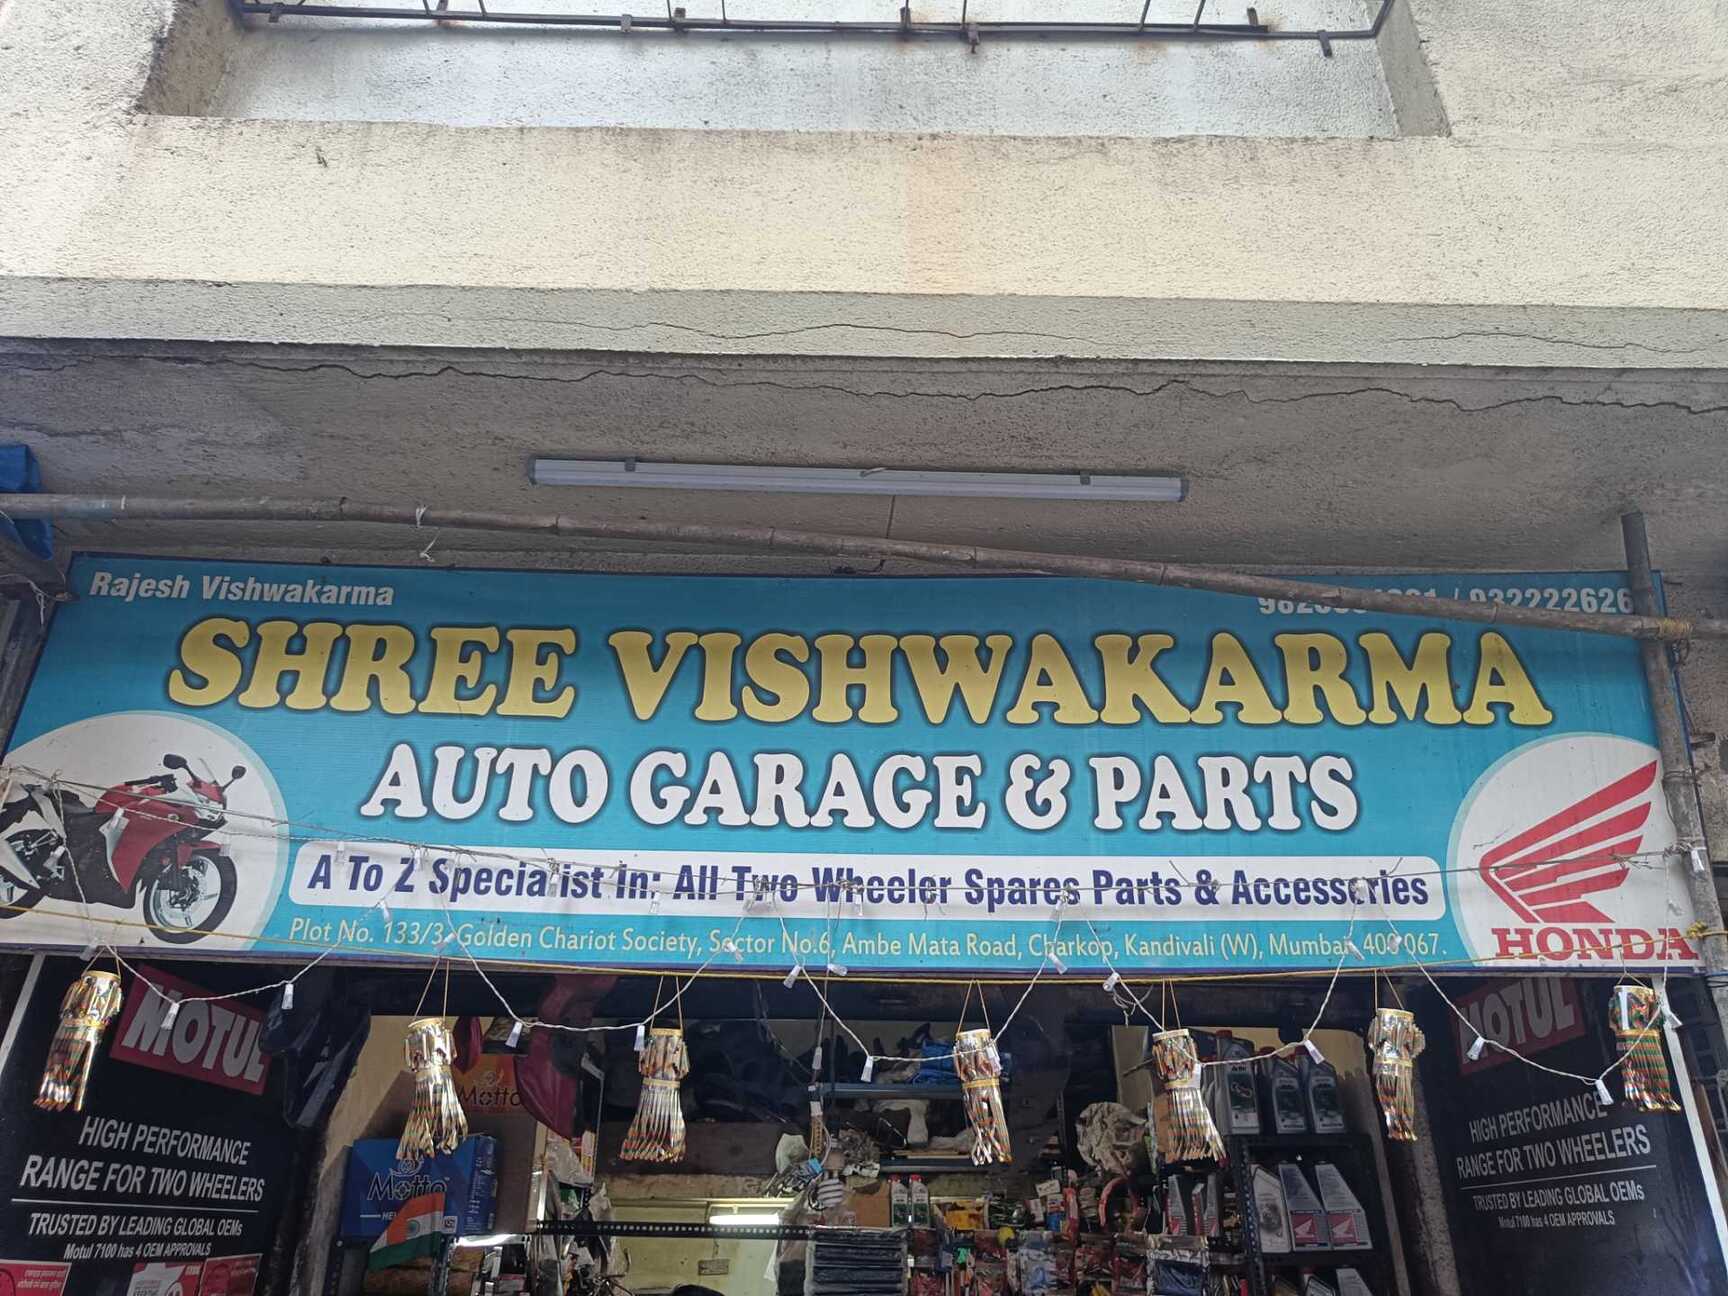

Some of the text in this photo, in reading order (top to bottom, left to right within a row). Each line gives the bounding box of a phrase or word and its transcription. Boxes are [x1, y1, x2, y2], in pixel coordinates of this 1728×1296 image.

[89, 571, 394, 606] Rajesh Vishwakarma
[168, 617, 1554, 726] SHREE VISHWAKARMA
[360, 743, 1359, 832] AUTO GARAGE & PARTS
[307, 854, 332, 890] A
[348, 855, 384, 892] To
[395, 857, 417, 893] Z
[429, 857, 604, 902] Speciaist
[616, 863, 661, 899] In:
[672, 864, 718, 901] All
[731, 865, 798, 902] Two
[812, 867, 951, 904] Wheeler
[965, 868, 1080, 913] Spares
[1093, 869, 1182, 905] Parts
[1194, 869, 1219, 905] &
[289, 917, 332, 942] Plot
[339, 919, 374, 944] No.
[456, 923, 534, 948] Golden
[539, 925, 617, 951] Chariot
[623, 928, 702, 959] Society,
[843, 931, 901, 956] Ambe
[907, 932, 960, 956] Mata
[966, 933, 1022, 960] Road,
[1028, 933, 1119, 961] Charkop,
[1124, 933, 1215, 957] Kandivali
[1220, 933, 1264, 960] (W),
[1404, 932, 1447, 956] 067.
[1491, 926, 1700, 961] HONDA
[121, 982, 265, 1083] MOTUL
[1458, 976, 1575, 1065] MOTUL
[78, 1115, 251, 1165] HIGH PERFORMANCE
[1468, 1091, 1607, 1144] HIGH PERFORMANCE
[1456, 1123, 1650, 1179] RANGE FOR TWO WHEELERS
[19, 1154, 265, 1202] RANGE FOR TWO WHEELERS
[367, 1172, 447, 1201] Motto
[1473, 1180, 1645, 1211] TRUSTED BY LEADING GLOBAL OEMs
[28, 1212, 243, 1236] TRUSTED BY LEADING GLOBAL OEMs
[1567, 1210, 1615, 1226] APPROVALS
[64, 1242, 212, 1260] Motul 7100 has 4 OEM APPROVALS
